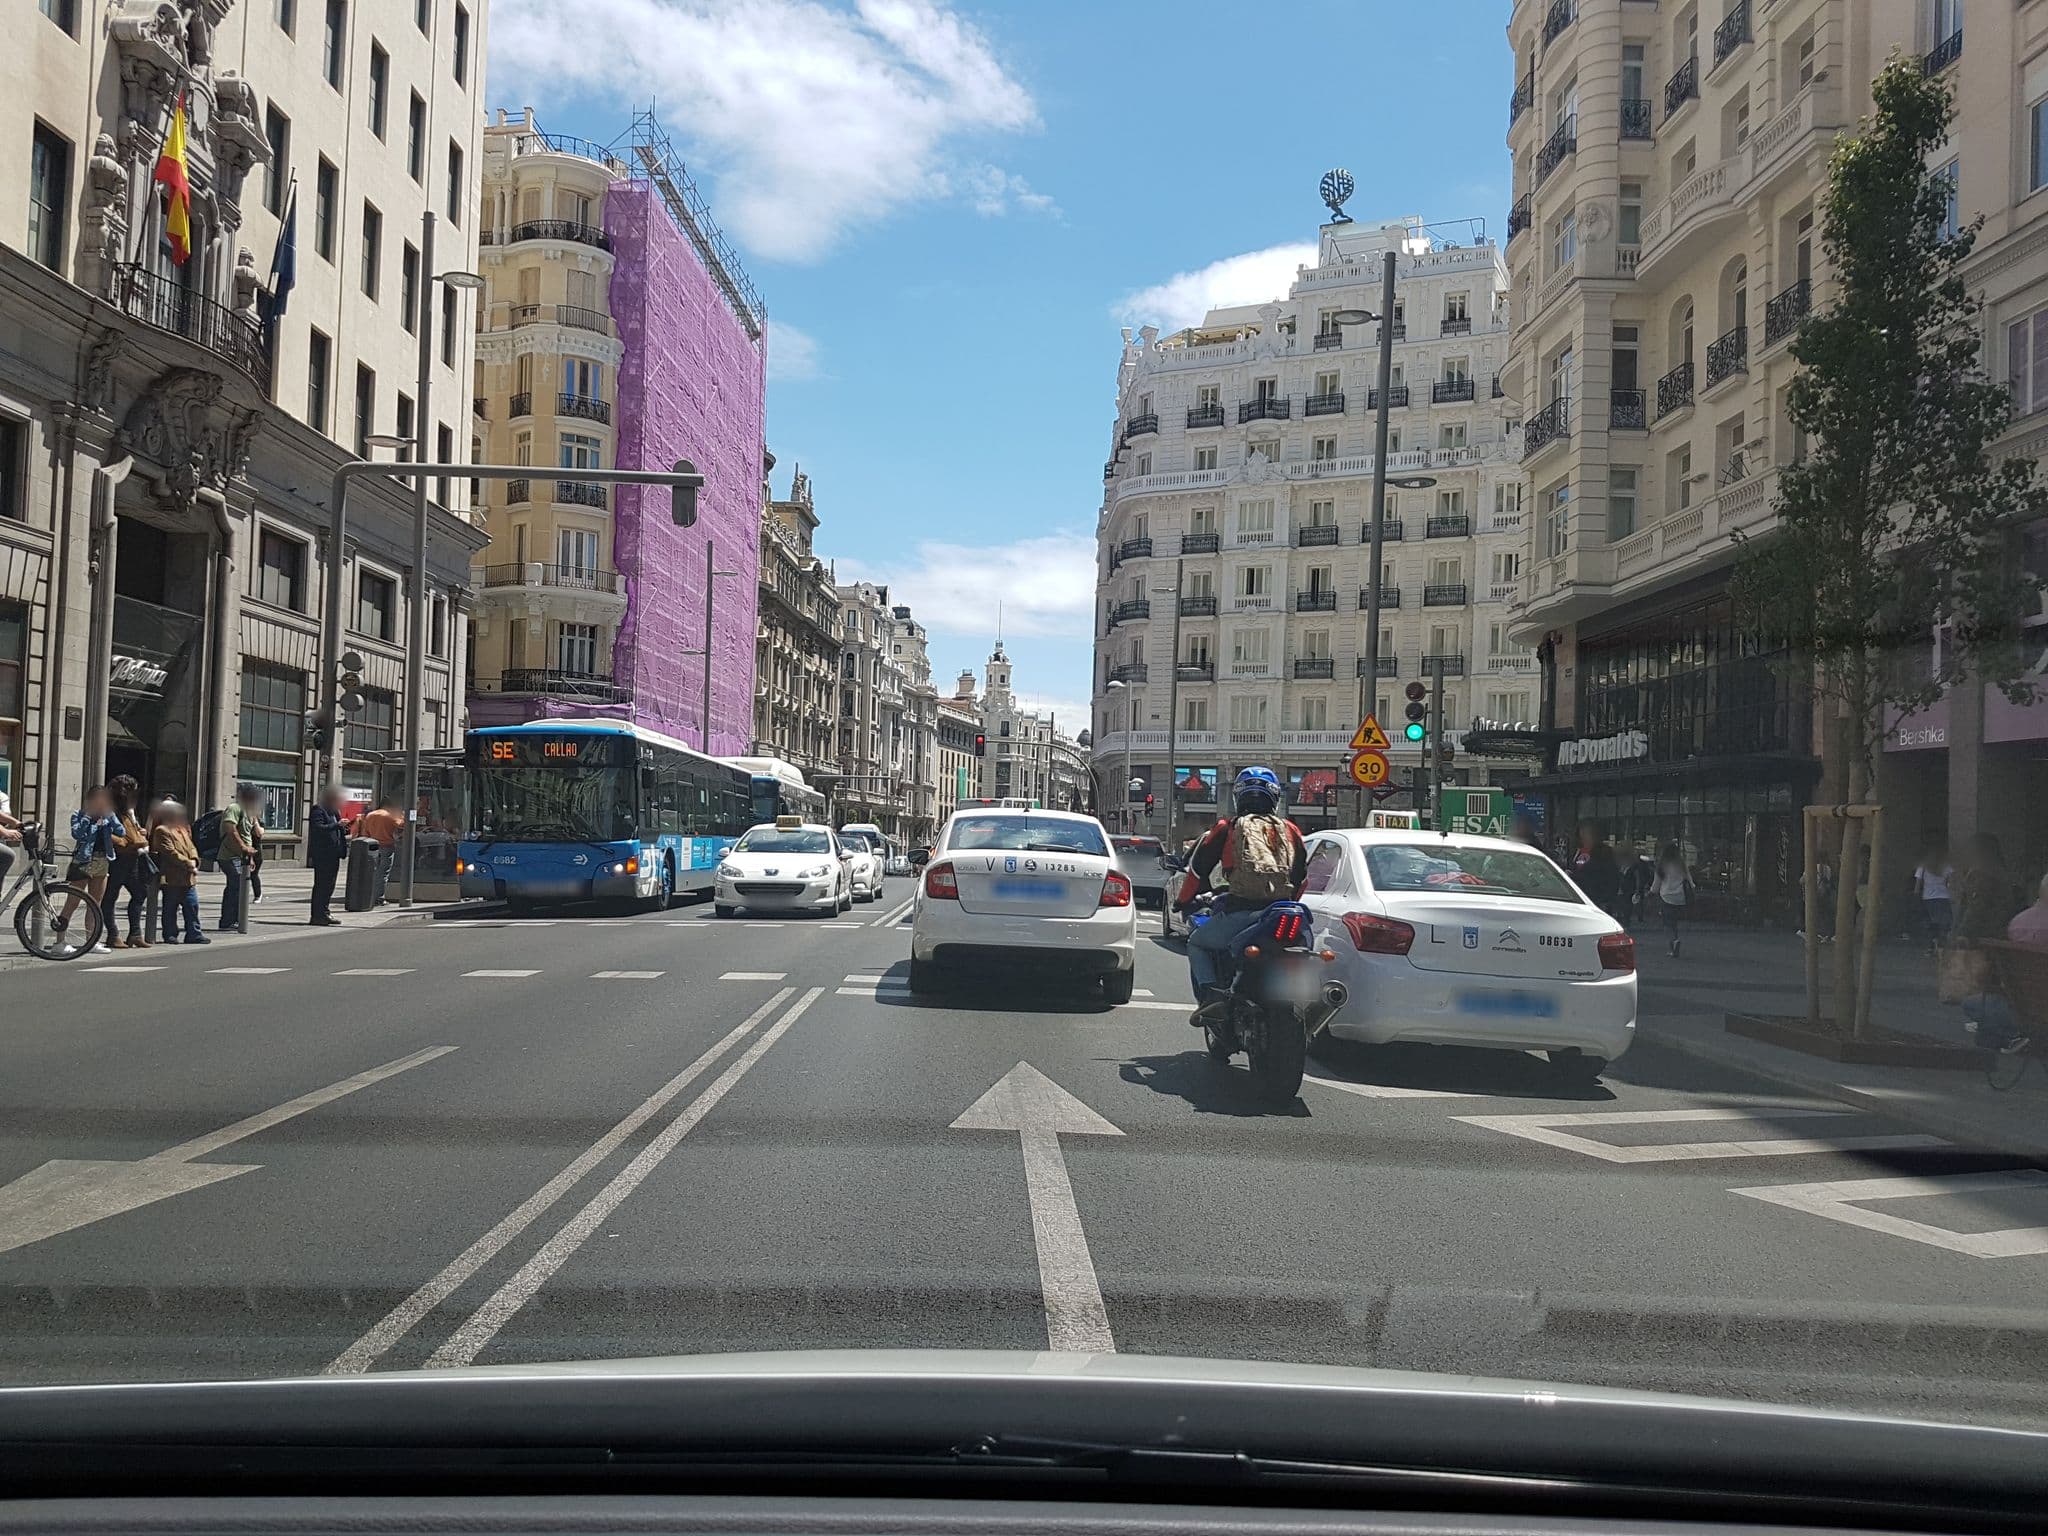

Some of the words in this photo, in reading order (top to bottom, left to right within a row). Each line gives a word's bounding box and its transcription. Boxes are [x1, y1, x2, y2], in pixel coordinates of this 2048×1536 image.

[1900, 726, 1945, 746] Bershka
[492, 742, 514, 759] SE
[544, 742, 578, 757] CALLAO
[1557, 730, 1648, 766] McDonald's
[1358, 762, 1381, 775] 30
[1387, 816, 1409, 829] TAXI
[985, 857, 996, 871] V
[1431, 924, 1446, 944] L
